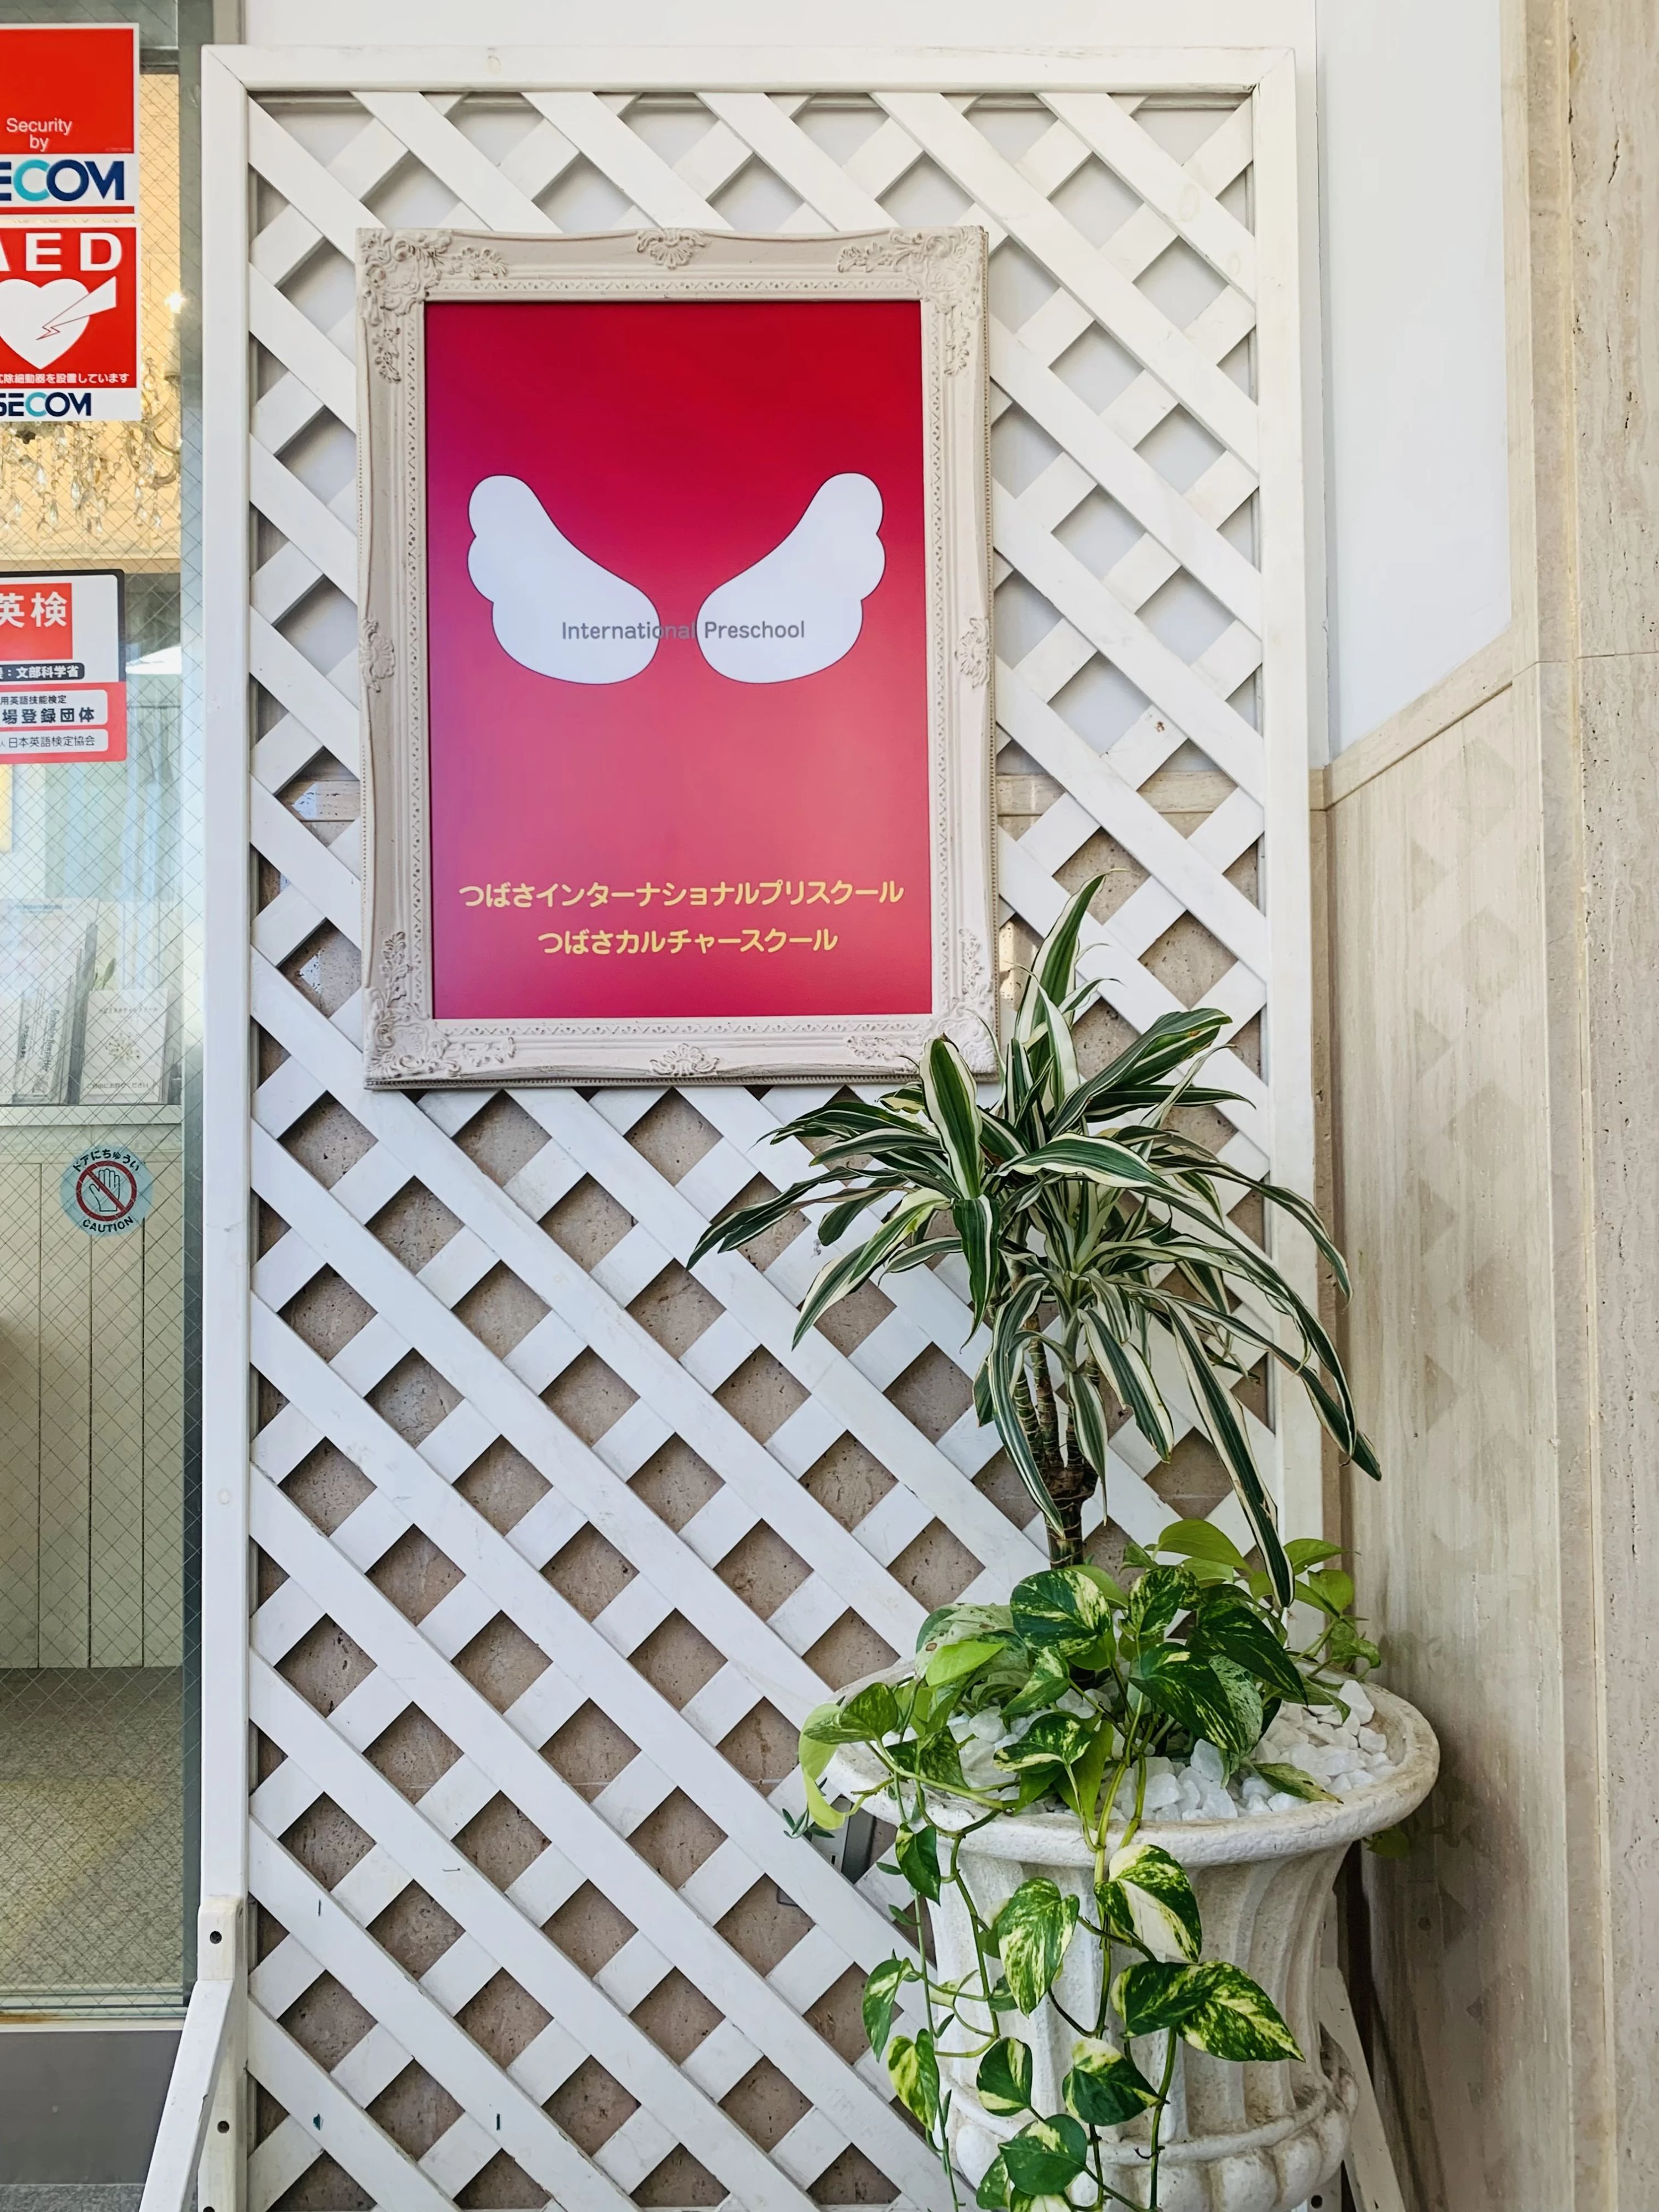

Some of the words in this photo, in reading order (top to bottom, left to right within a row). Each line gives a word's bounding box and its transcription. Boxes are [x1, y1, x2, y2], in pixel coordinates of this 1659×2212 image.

[6, 117, 72, 136] Security
[29, 134, 49, 152] by
[0, 591, 67, 628] 英検
[561, 620, 697, 640] International
[704, 620, 805, 639] Preschool
[0, 695, 66, 706] 用英語技能検定
[2, 707, 95, 724] 場登録団体
[458, 879, 905, 908] つばさインターナショナルプリスクール
[538, 927, 838, 955] つばさカルチャースクール
[73, 1149, 139, 1172] ドアにちゅうい
[83, 1216, 133, 1233] CAUTION
